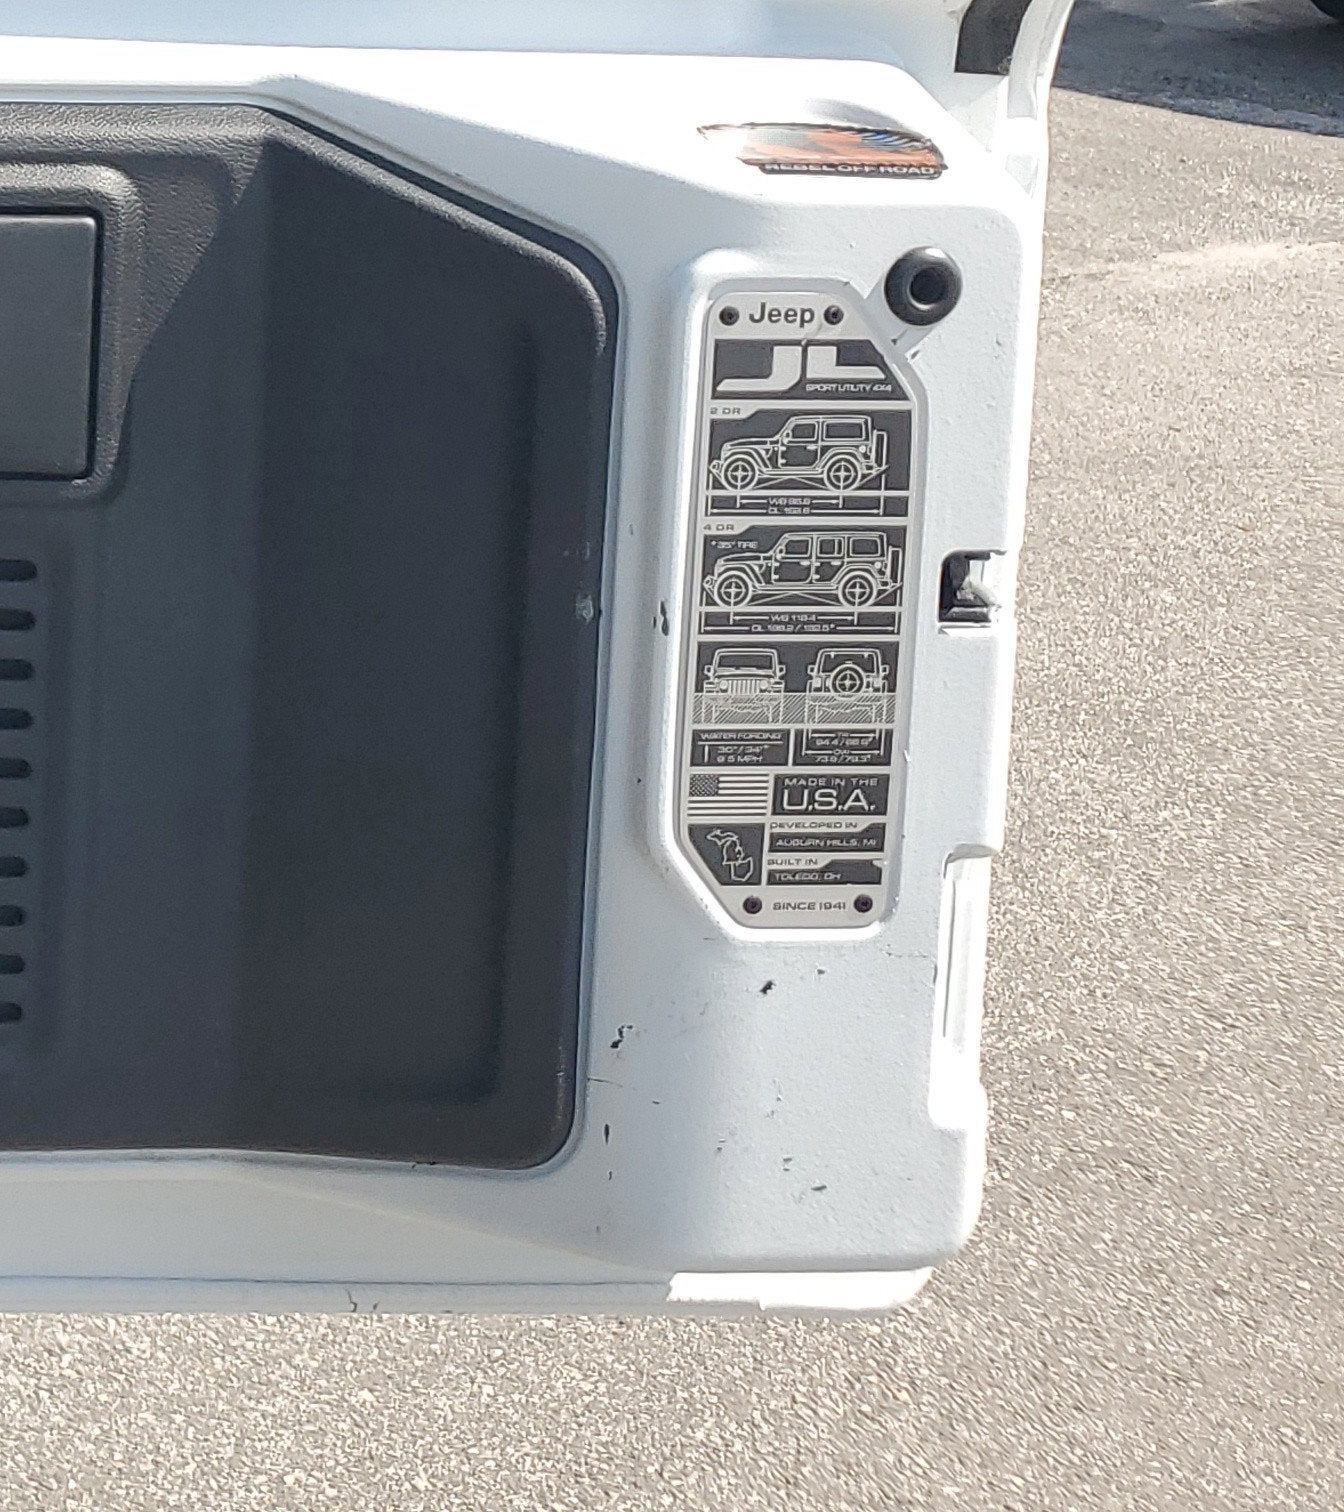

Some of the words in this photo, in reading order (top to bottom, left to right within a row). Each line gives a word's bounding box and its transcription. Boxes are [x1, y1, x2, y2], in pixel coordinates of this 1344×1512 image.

[748, 301, 815, 328] Jeep
[715, 345, 887, 392] JL
[722, 407, 741, 415] DR
[716, 523, 734, 531] DR
[784, 777, 826, 787] MADE
[831, 777, 846, 787] IN
[850, 777, 879, 787] THE
[782, 788, 876, 811] U.S.A.
[769, 821, 843, 829] DEVELOPED
[844, 821, 858, 829] IN
[767, 858, 803, 866] BUILT
[804, 858, 818, 866] IN
[772, 901, 816, 911] SINCE
[818, 901, 847, 911] 1941
